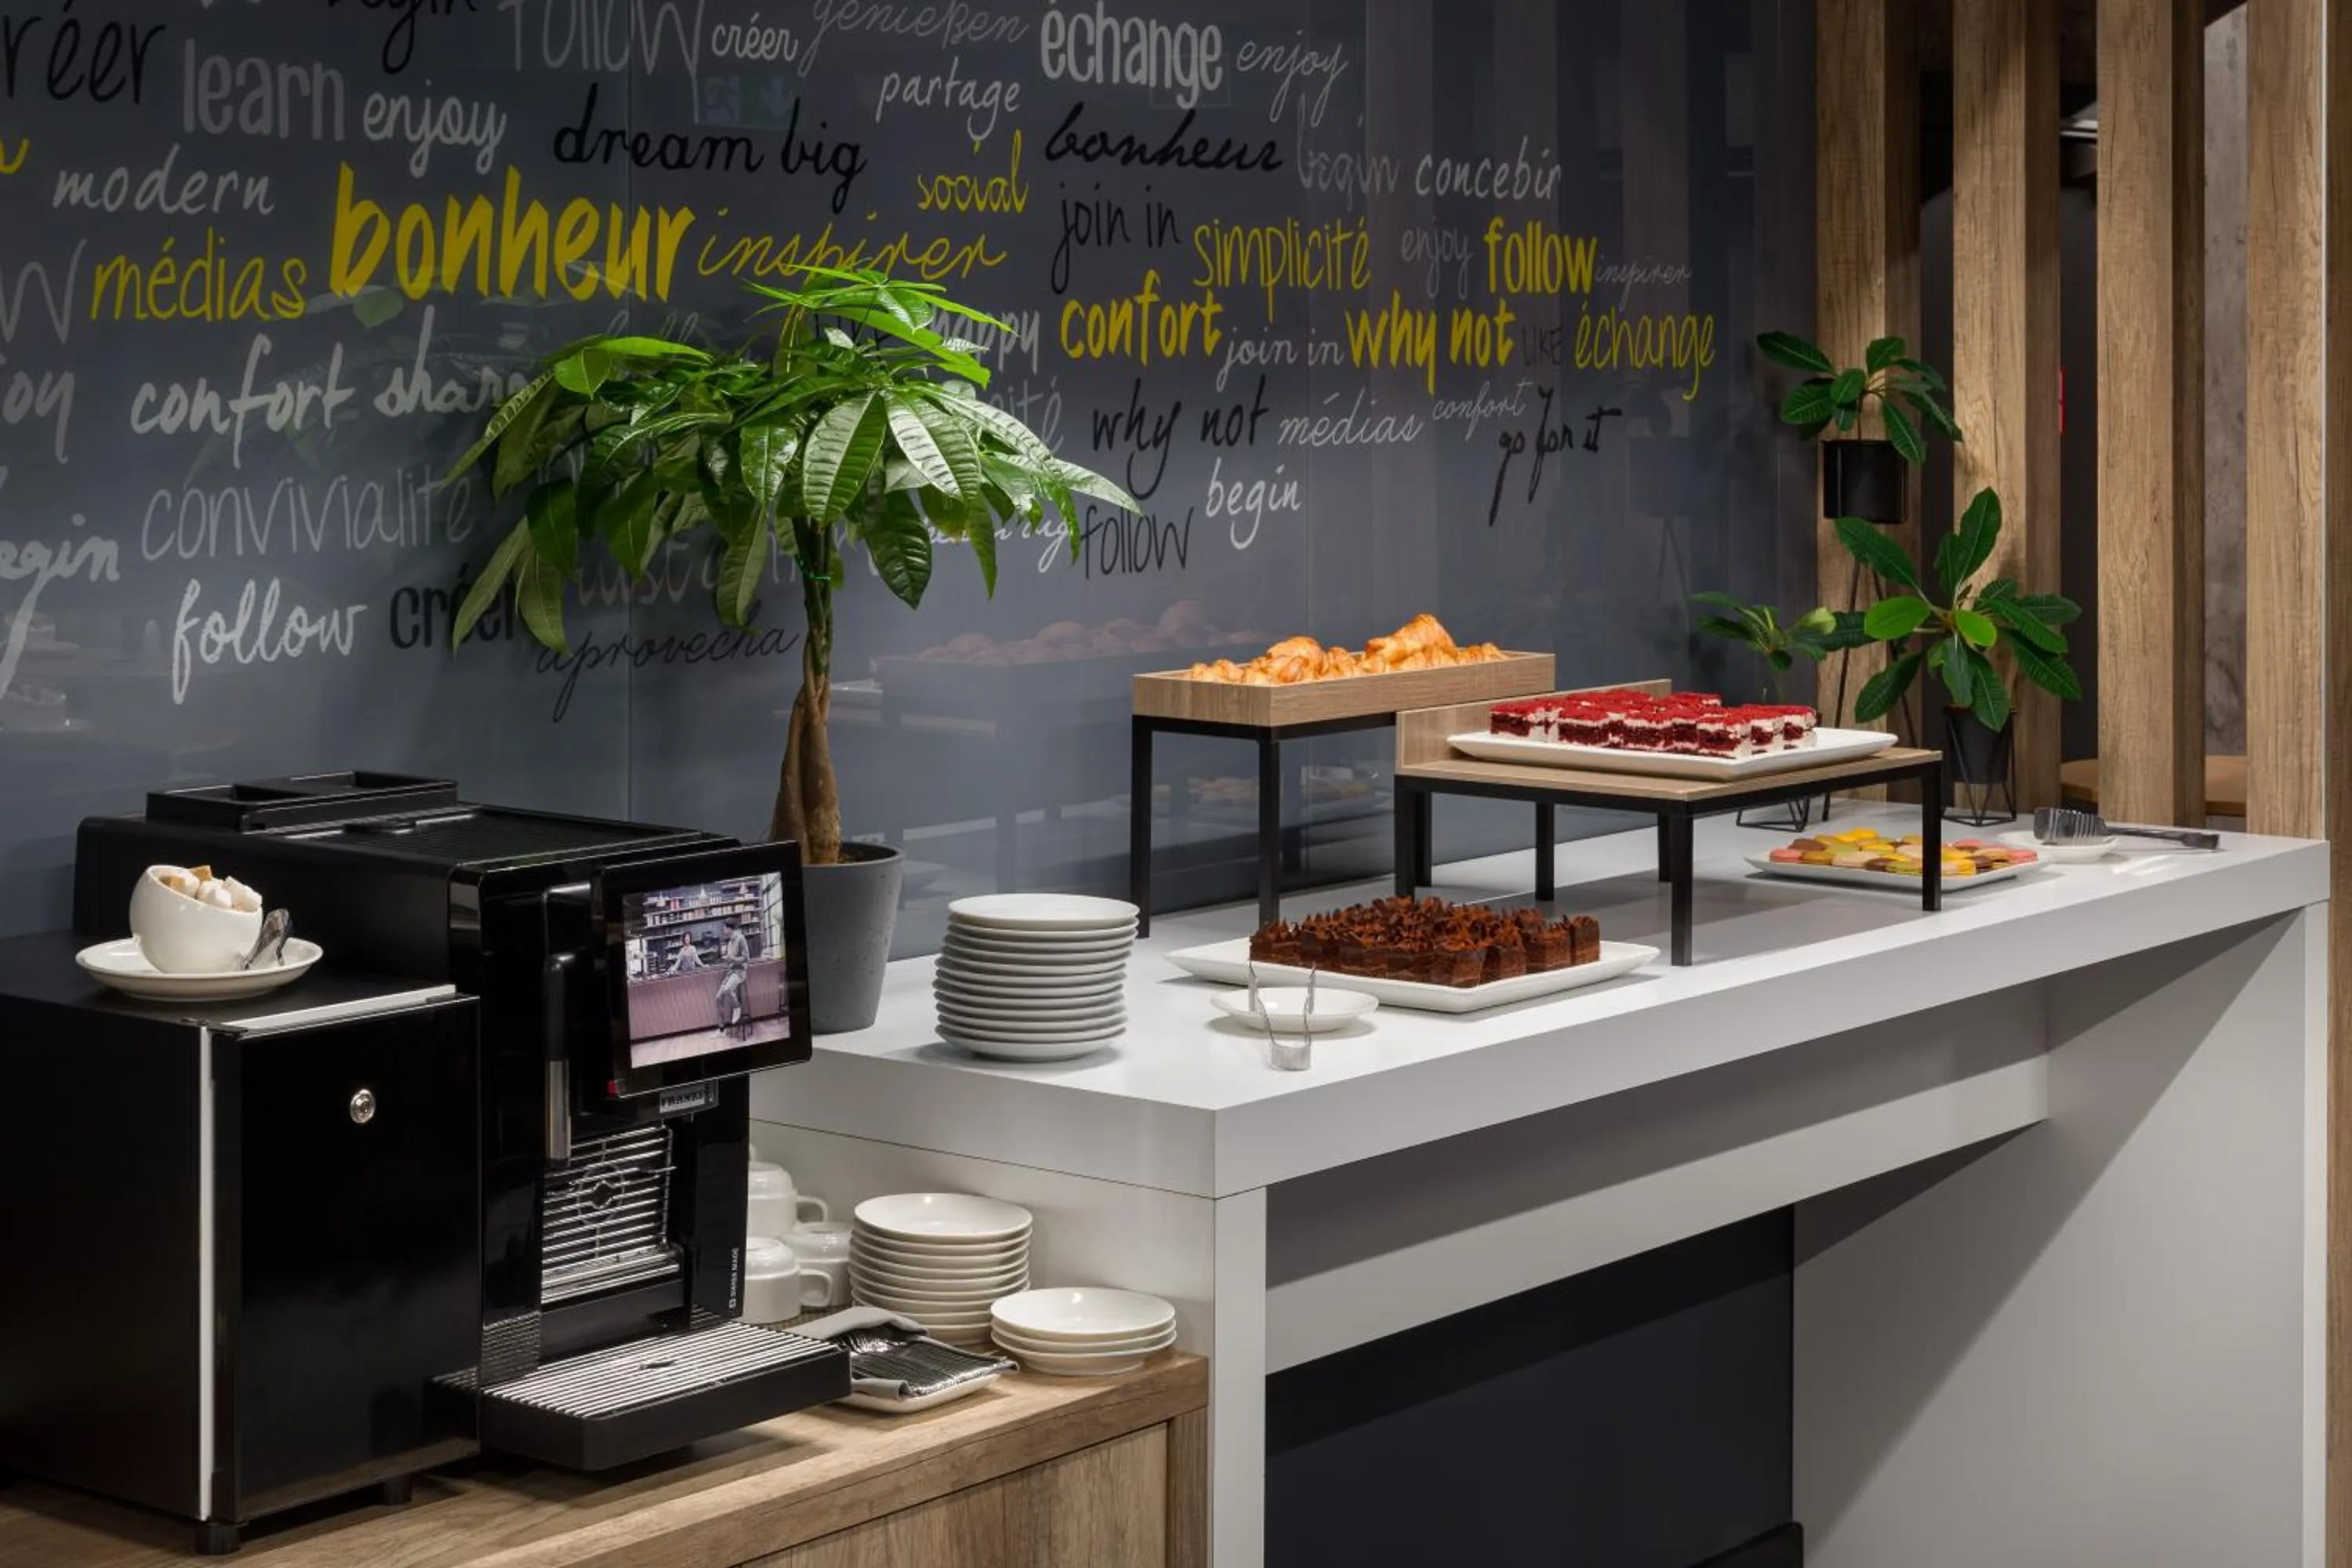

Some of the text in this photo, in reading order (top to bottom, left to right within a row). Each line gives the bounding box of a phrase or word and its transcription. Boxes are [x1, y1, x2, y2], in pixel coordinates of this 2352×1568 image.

[2, 0, 166, 104] réer
[712, 13, 800, 61] créer
[1041, 0, 1223, 109] échange
[1236, 31, 1349, 127] enjoy
[183, 38, 346, 142] learn
[362, 79, 508, 177] enjoy
[875, 56, 1020, 142] partage
[1044, 102, 1283, 171] bonheur
[52, 143, 275, 215] modern
[554, 82, 868, 214] dream big
[916, 129, 1029, 213] social
[1415, 136, 1563, 201] concebir
[90, 226, 307, 322] médias
[329, 161, 696, 303] bonheur
[698, 207, 1007, 320] inspirer
[1051, 183, 1183, 295] join in
[1192, 216, 1372, 324] simplicité
[1483, 216, 1598, 294] follow
[1060, 269, 1224, 367] confort
[1216, 327, 1344, 392] join in
[1345, 290, 1516, 397] why not
[1574, 299, 1715, 401] échange
[129, 332, 356, 469] confort
[1093, 377, 1181, 501] why
[1200, 373, 1269, 448] not
[1277, 387, 1424, 448] médias
[1080, 505, 1195, 579] follow
[1205, 456, 1302, 550] begin
[0, 465, 120, 702] egin
[171, 578, 369, 705] follow
